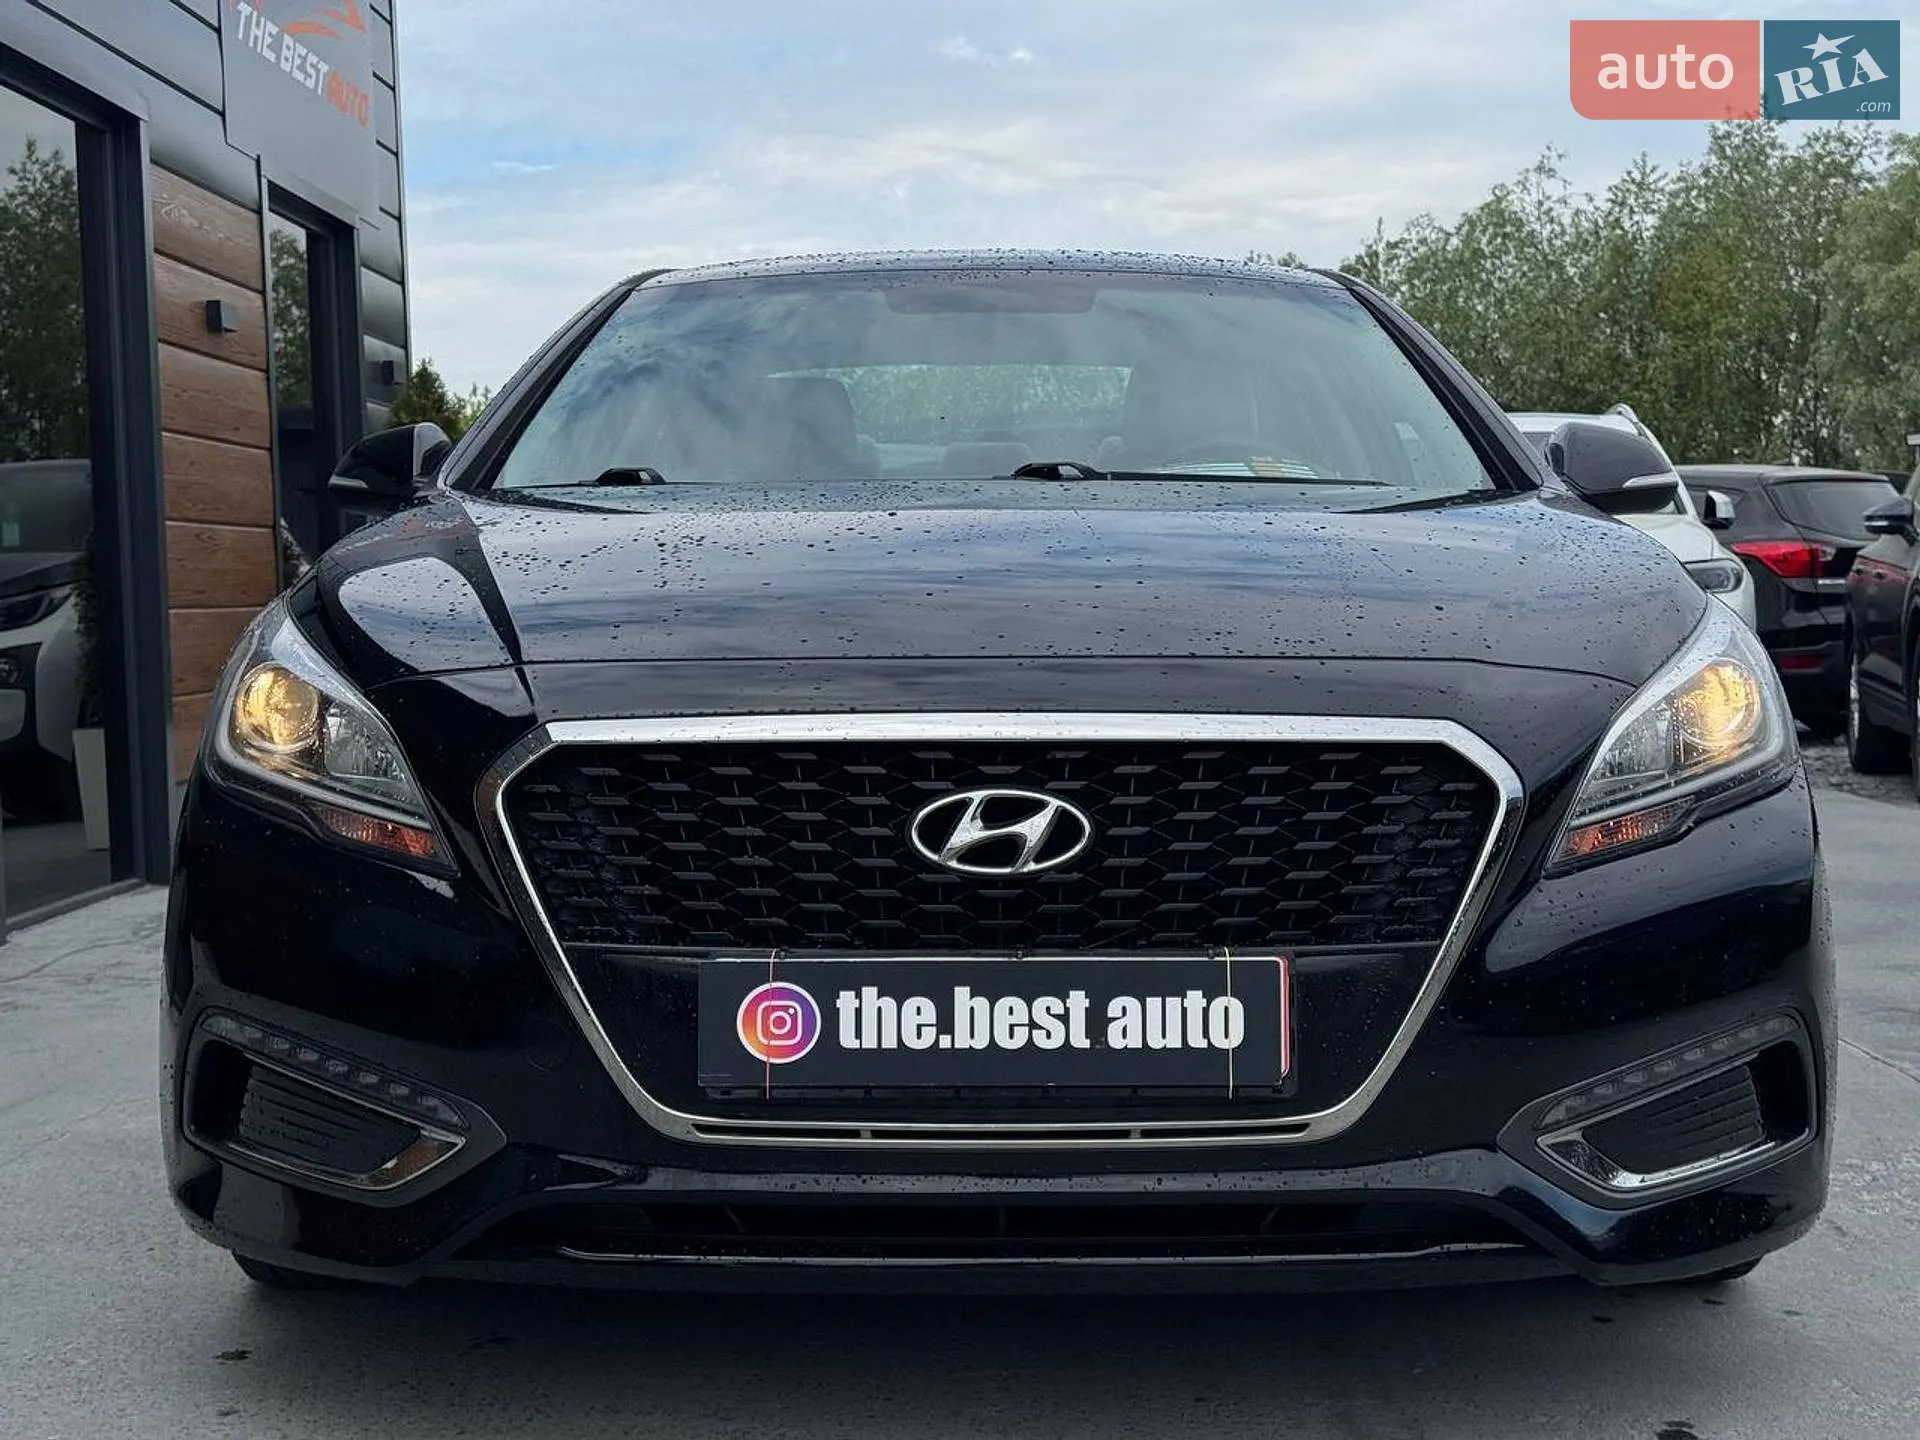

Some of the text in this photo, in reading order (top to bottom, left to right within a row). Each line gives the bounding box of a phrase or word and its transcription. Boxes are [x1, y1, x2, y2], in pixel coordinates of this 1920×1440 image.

[237, 2, 370, 128] THE BEST AUTO
[836, 986, 1245, 1050] the.best auto
